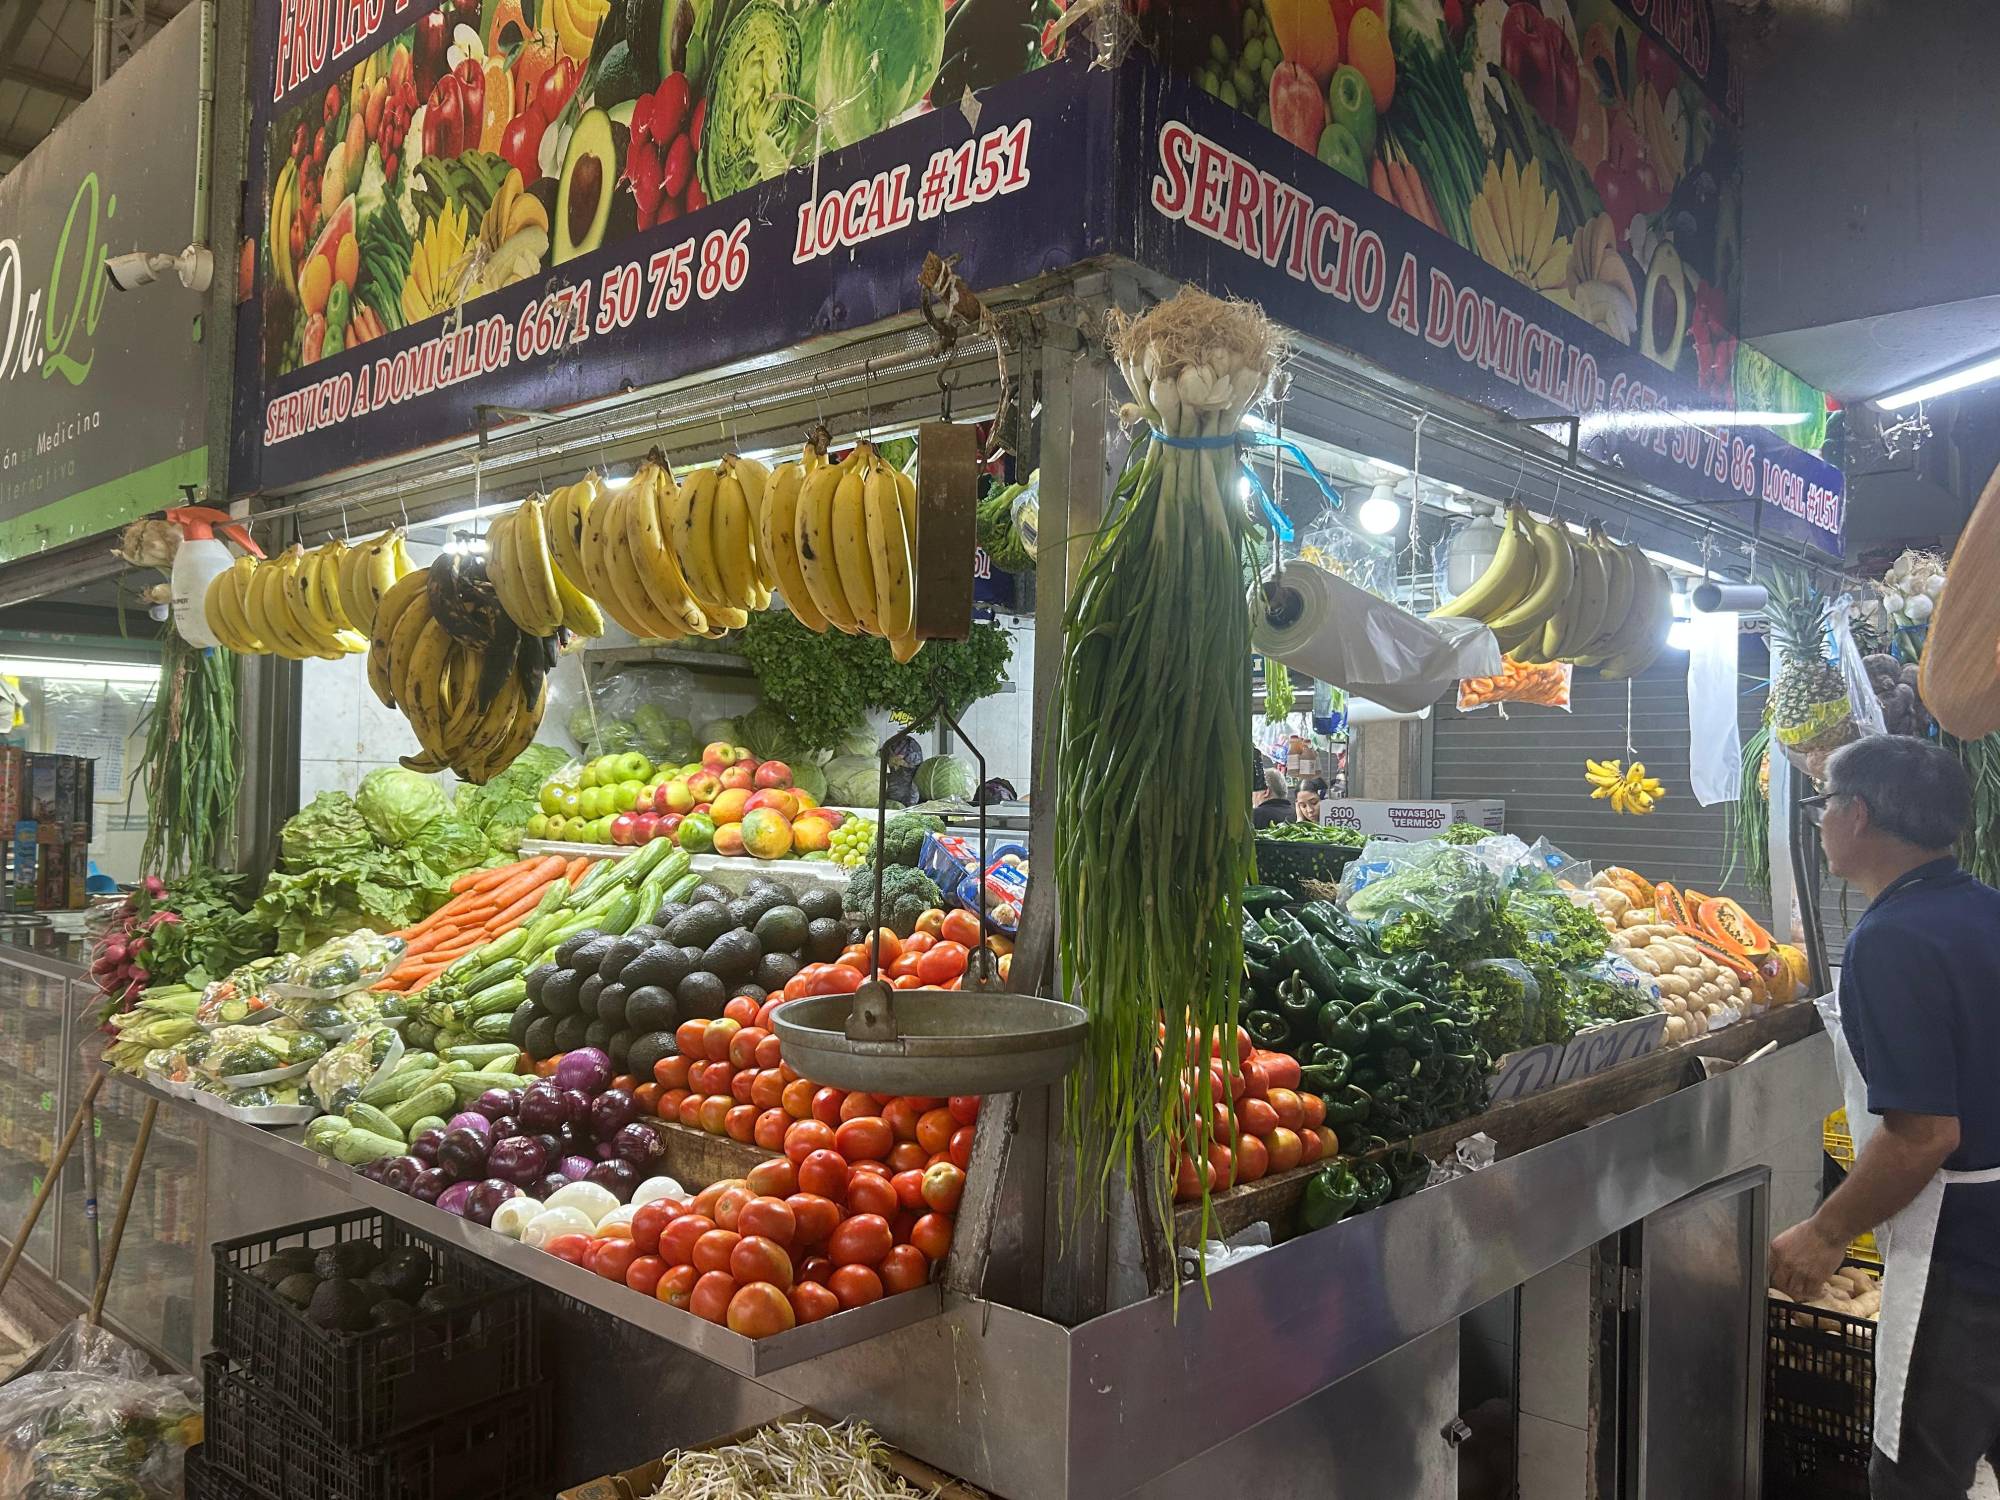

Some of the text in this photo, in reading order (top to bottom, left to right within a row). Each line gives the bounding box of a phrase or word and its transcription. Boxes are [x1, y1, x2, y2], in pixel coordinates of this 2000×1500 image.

[274, 0, 385, 103] FRUT
[264, 118, 1031, 446] SERVICIO A DOMICILIO: 6671 50 75 86 LOCAL #151
[1151, 120, 1386, 313] SERVICIO
[1387, 252, 1419, 336] A
[1425, 267, 1605, 413] DOMICILIO:
[1731, 437, 1756, 496] 86
[1762, 458, 1806, 518] LOCAL
[1806, 482, 1841, 535] #151
[36, 411, 100, 456] Medicina
[1330, 807, 1355, 820] 300
[1388, 808, 1426, 819] ENVASE
[1435, 810, 1446, 820] L.
[1393, 818, 1443, 829] TERMICO
